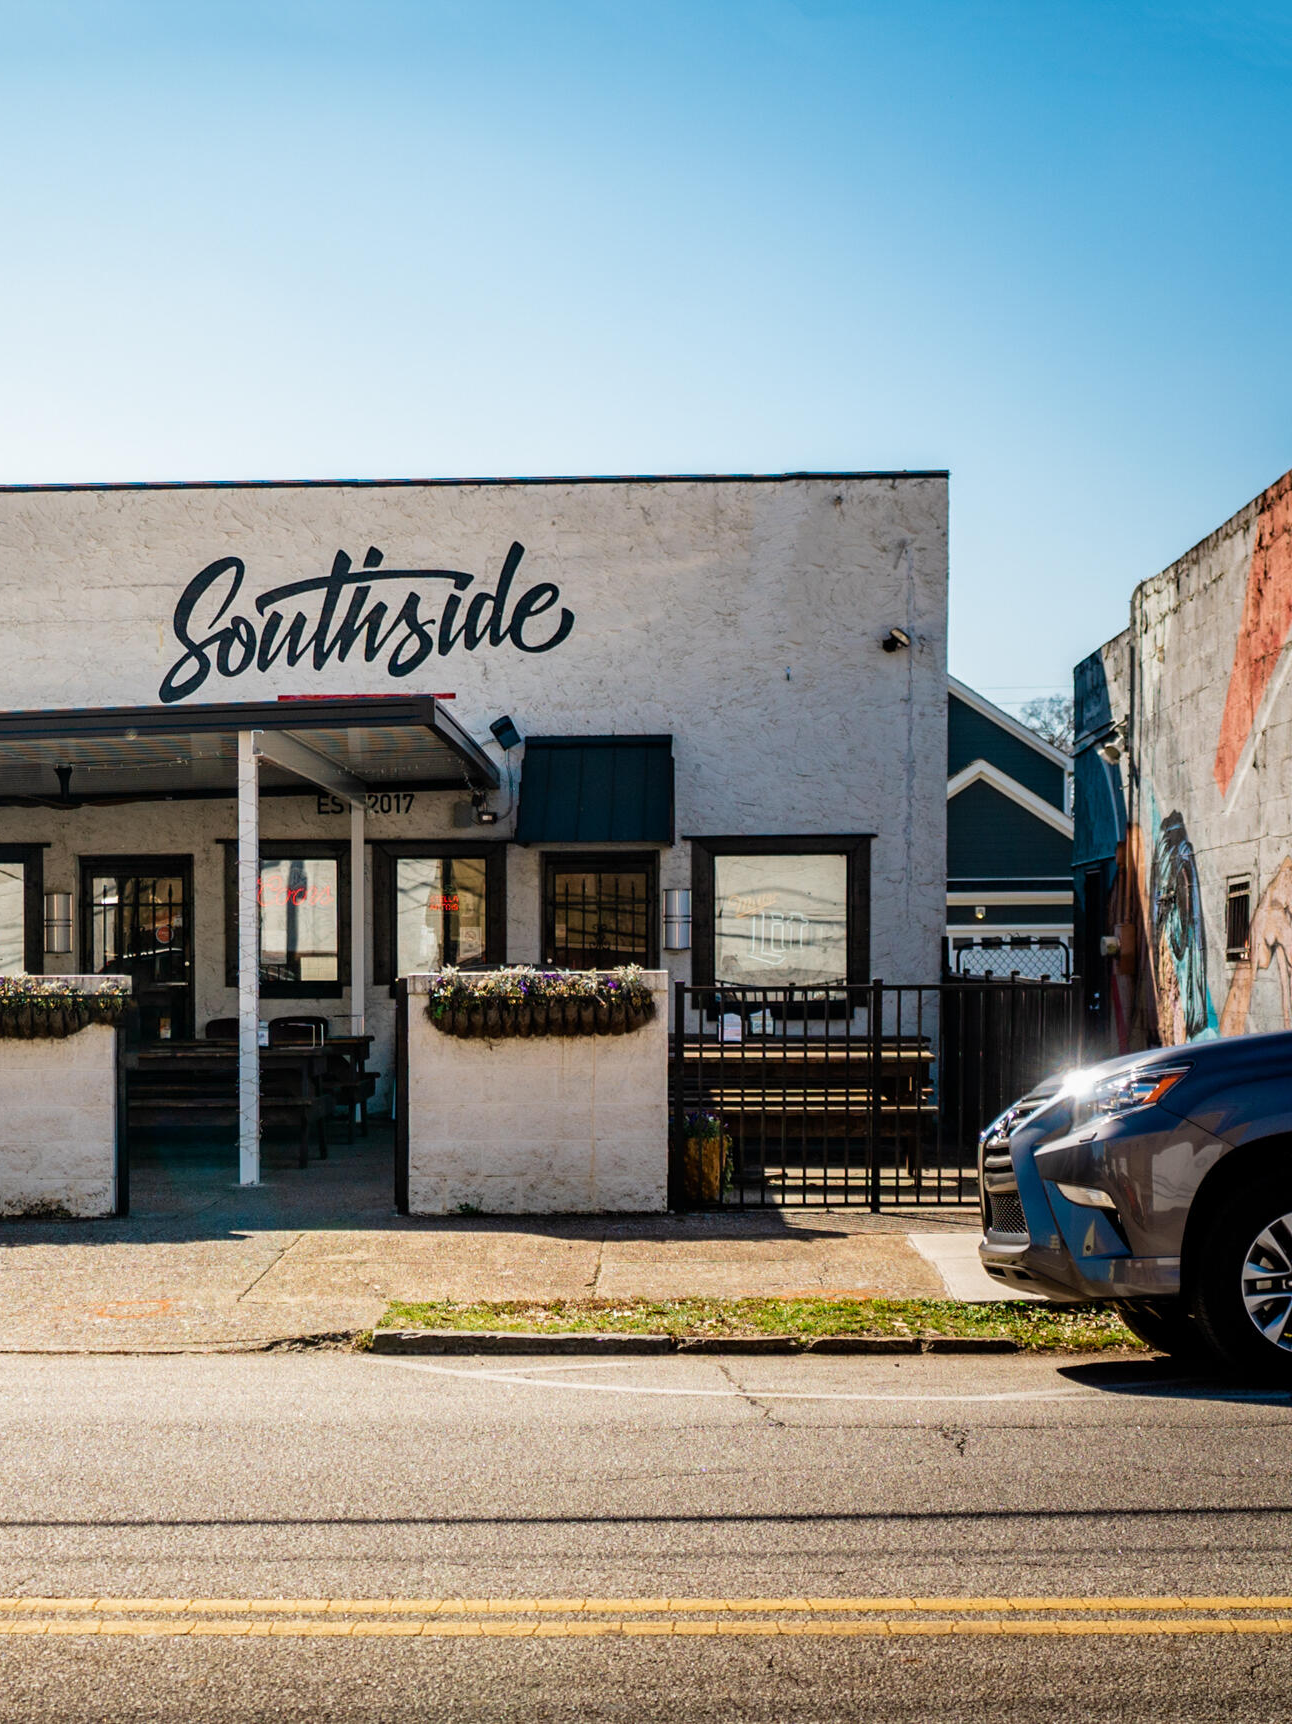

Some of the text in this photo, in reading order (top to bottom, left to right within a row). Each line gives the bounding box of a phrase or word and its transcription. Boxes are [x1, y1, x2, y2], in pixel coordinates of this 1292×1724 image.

[159, 541, 575, 704] Southside
[317, 793, 415, 815] ES 2017
[257, 873, 334, 907] Coors
